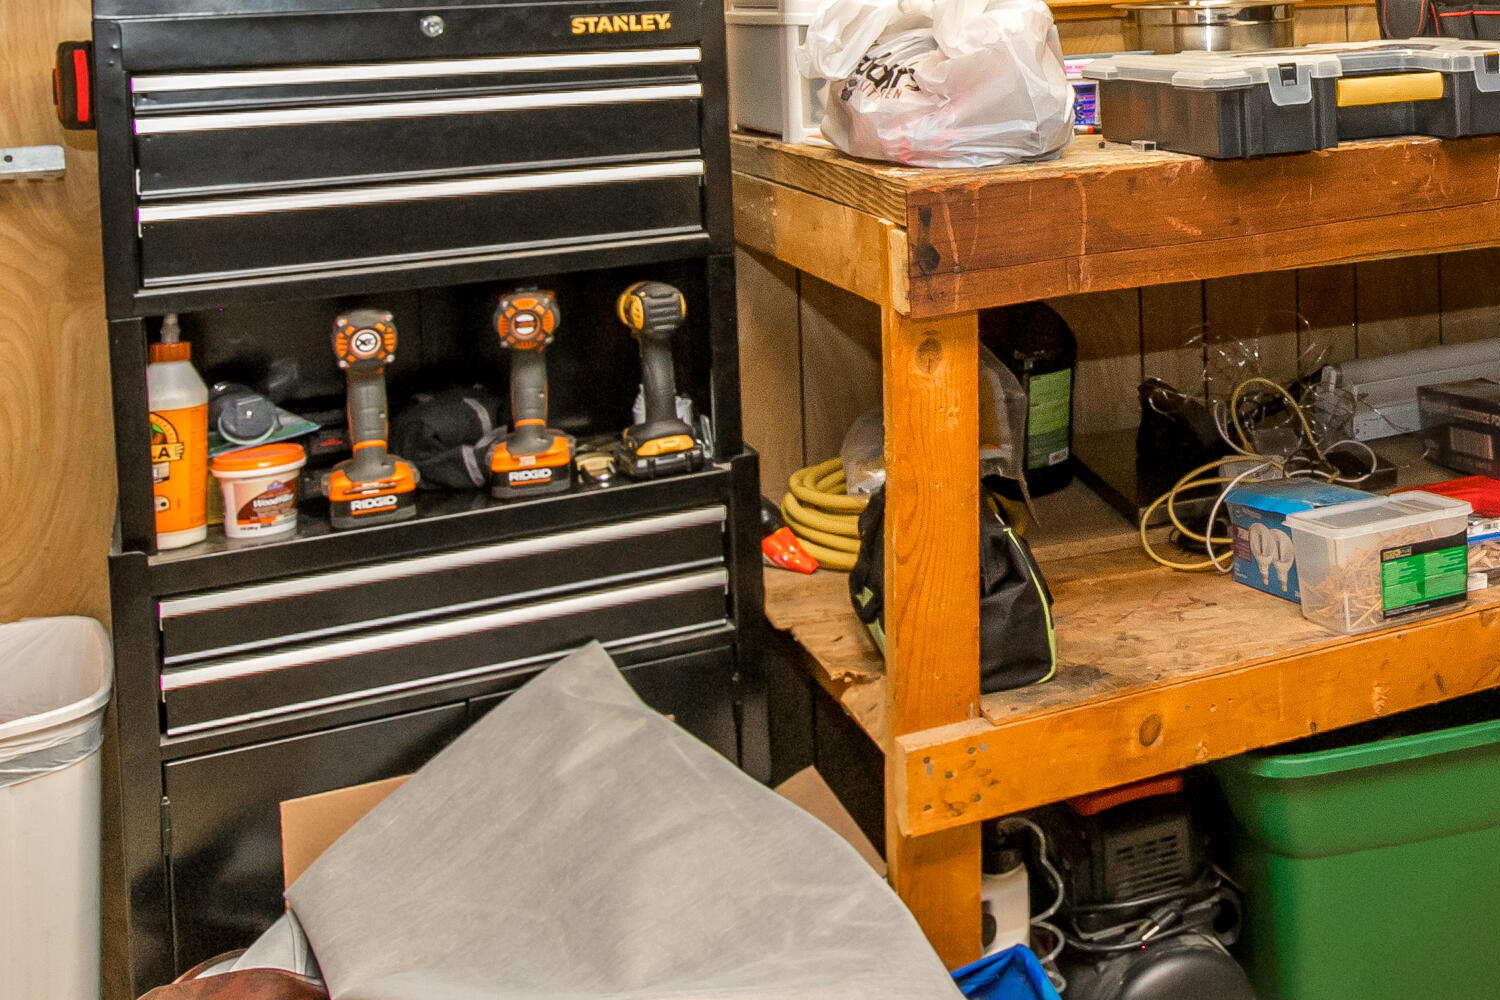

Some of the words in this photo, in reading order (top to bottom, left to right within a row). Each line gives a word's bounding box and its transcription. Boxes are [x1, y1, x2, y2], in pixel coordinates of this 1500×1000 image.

[571, 13, 671, 35] STANLEY
[508, 467, 552, 481] RIDGID
[350, 494, 398, 511] RIDGID
